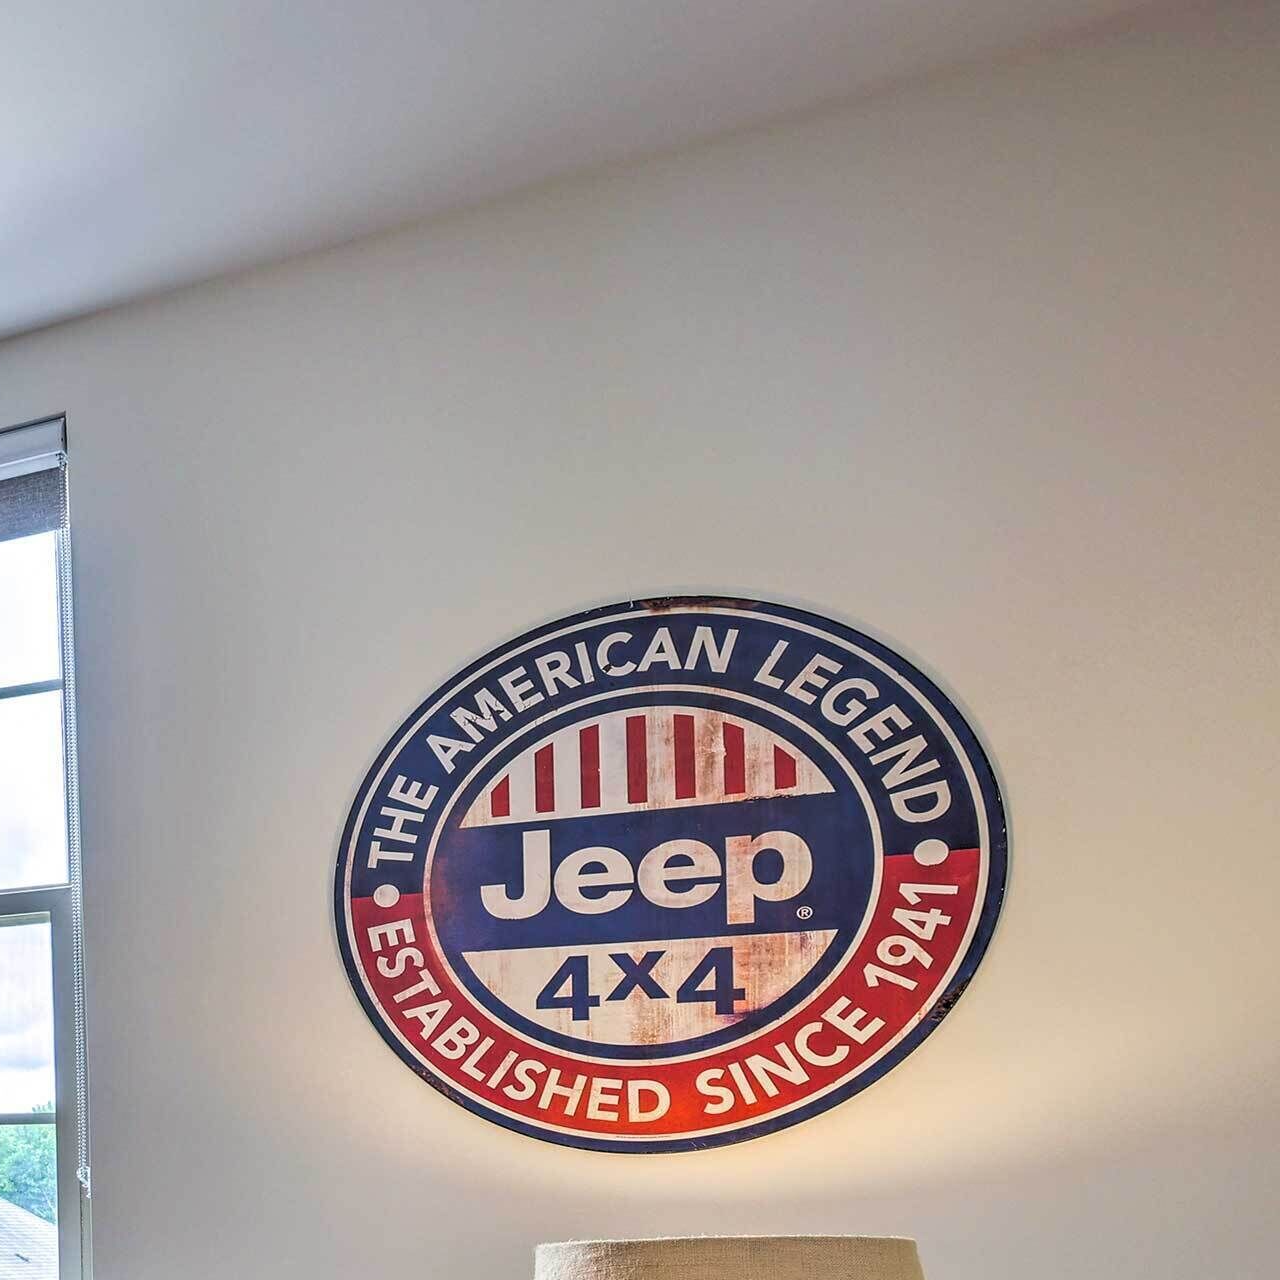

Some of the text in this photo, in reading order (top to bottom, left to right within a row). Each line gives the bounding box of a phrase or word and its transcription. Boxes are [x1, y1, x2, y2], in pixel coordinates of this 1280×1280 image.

[367, 626, 952, 869] THE AMERICAN LEGEND
[480, 829, 813, 925] Jeep
[367, 883, 959, 1123] ESTABLISHED SINCE 1941
